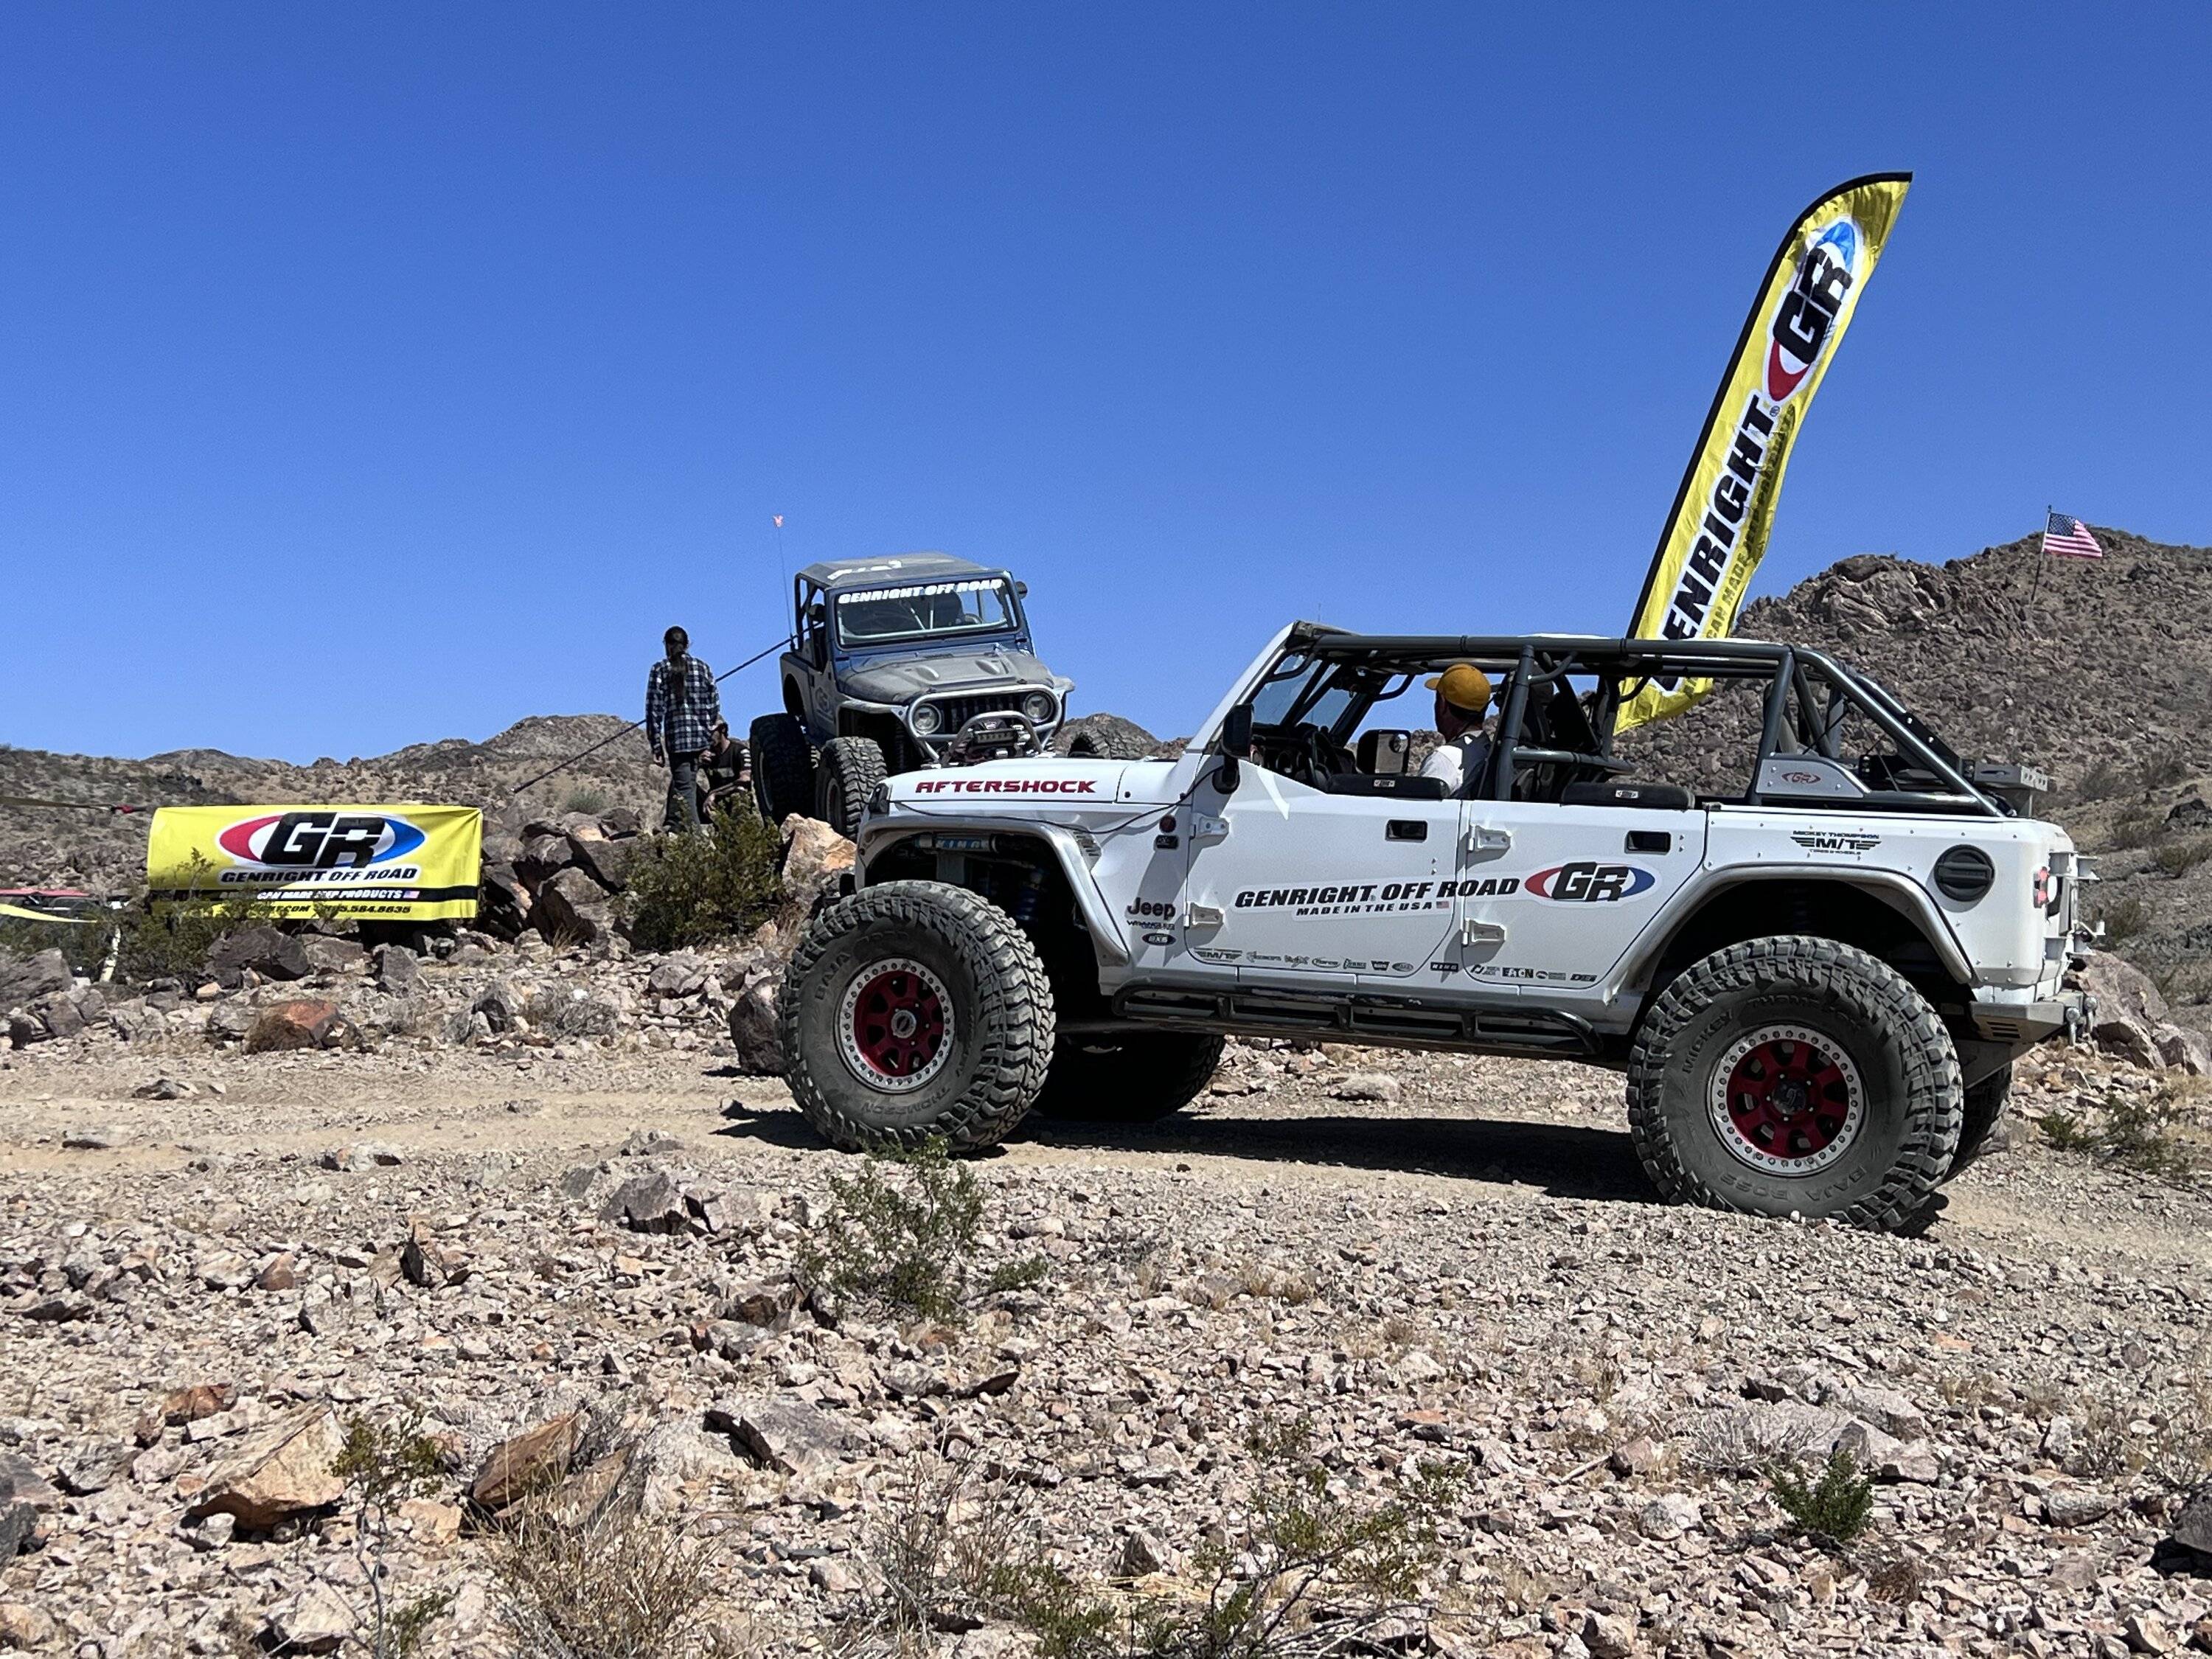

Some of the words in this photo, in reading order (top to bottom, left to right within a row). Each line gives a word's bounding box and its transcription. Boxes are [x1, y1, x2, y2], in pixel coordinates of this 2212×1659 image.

[1773, 246, 1853, 364] GR
[838, 587, 922, 603] GENRIGHT
[924, 584, 955, 595] OFF
[956, 579, 1004, 593] ROAD
[915, 780, 1097, 793] AFTERSHOCK
[262, 812, 386, 869] GR
[1816, 838, 1860, 849] M/T
[221, 871, 327, 883] GENRIGHT
[330, 871, 363, 881] OFF
[364, 869, 417, 880] ROAD
[1551, 862, 1629, 901] GR
[339, 889, 403, 899] PRODUCTS
[1234, 885, 1377, 908] GENRIGHT
[1380, 882, 1434, 901] OFF
[1436, 878, 1520, 897] ROAD
[1127, 897, 1175, 920] Jeep
[1296, 907, 1340, 917] MADE
[1344, 905, 1360, 914] IN
[1365, 903, 1394, 912] THE
[1398, 901, 1433, 911] USA
